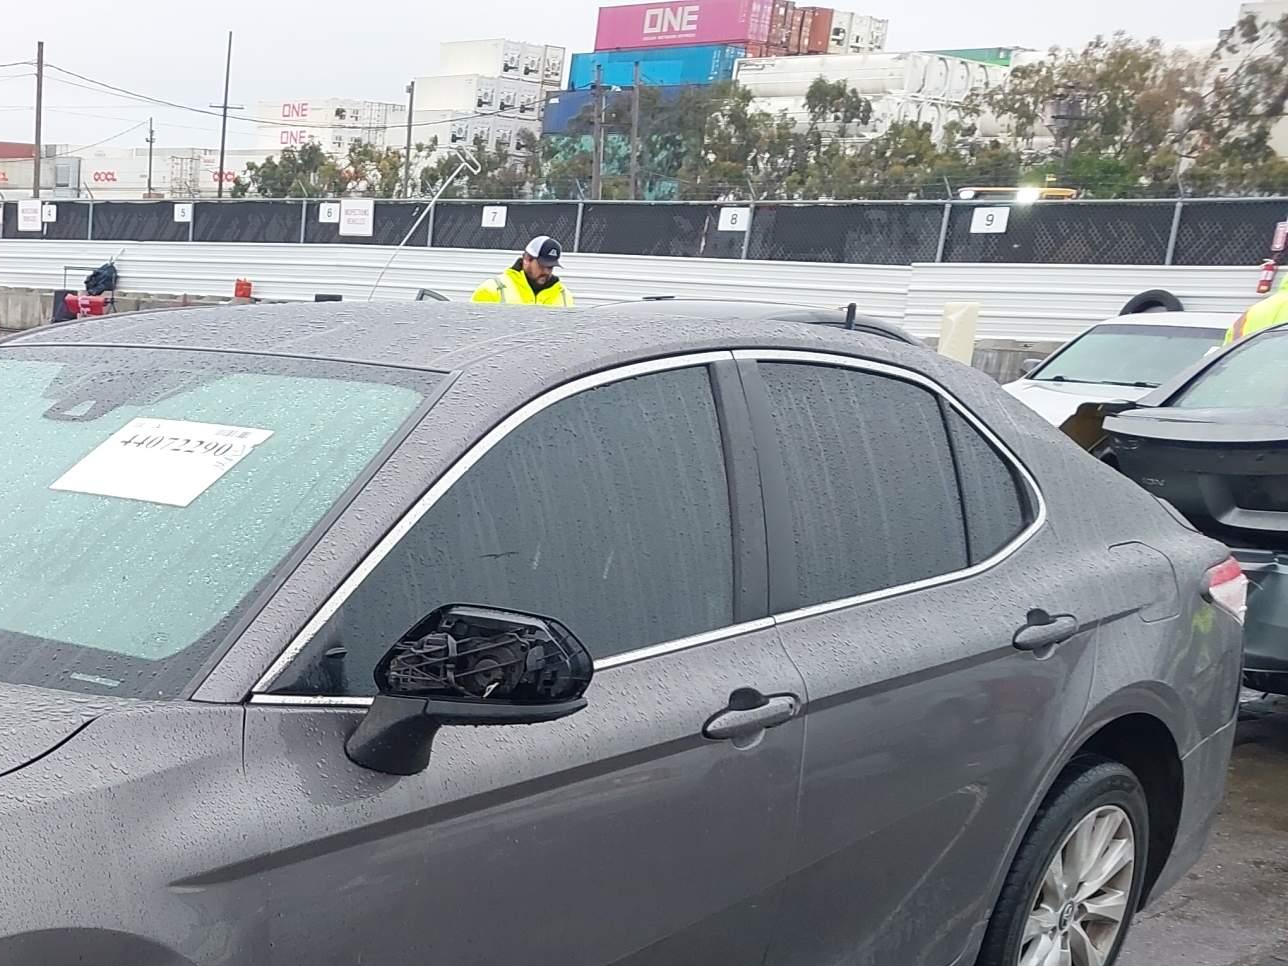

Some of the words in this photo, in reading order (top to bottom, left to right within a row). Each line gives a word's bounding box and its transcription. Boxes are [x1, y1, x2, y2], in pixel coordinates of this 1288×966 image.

[643, 5, 700, 34] ONE
[281, 103, 309, 118] ONE
[279, 130, 307, 145] ONE
[93, 171, 117, 182] OOCL
[180, 207, 186, 218] 5
[326, 207, 333, 218] 6
[490, 211, 498, 222] 7
[730, 213, 738, 225] 8
[985, 213, 995, 227] 9
[120, 434, 233, 456] 44072290
